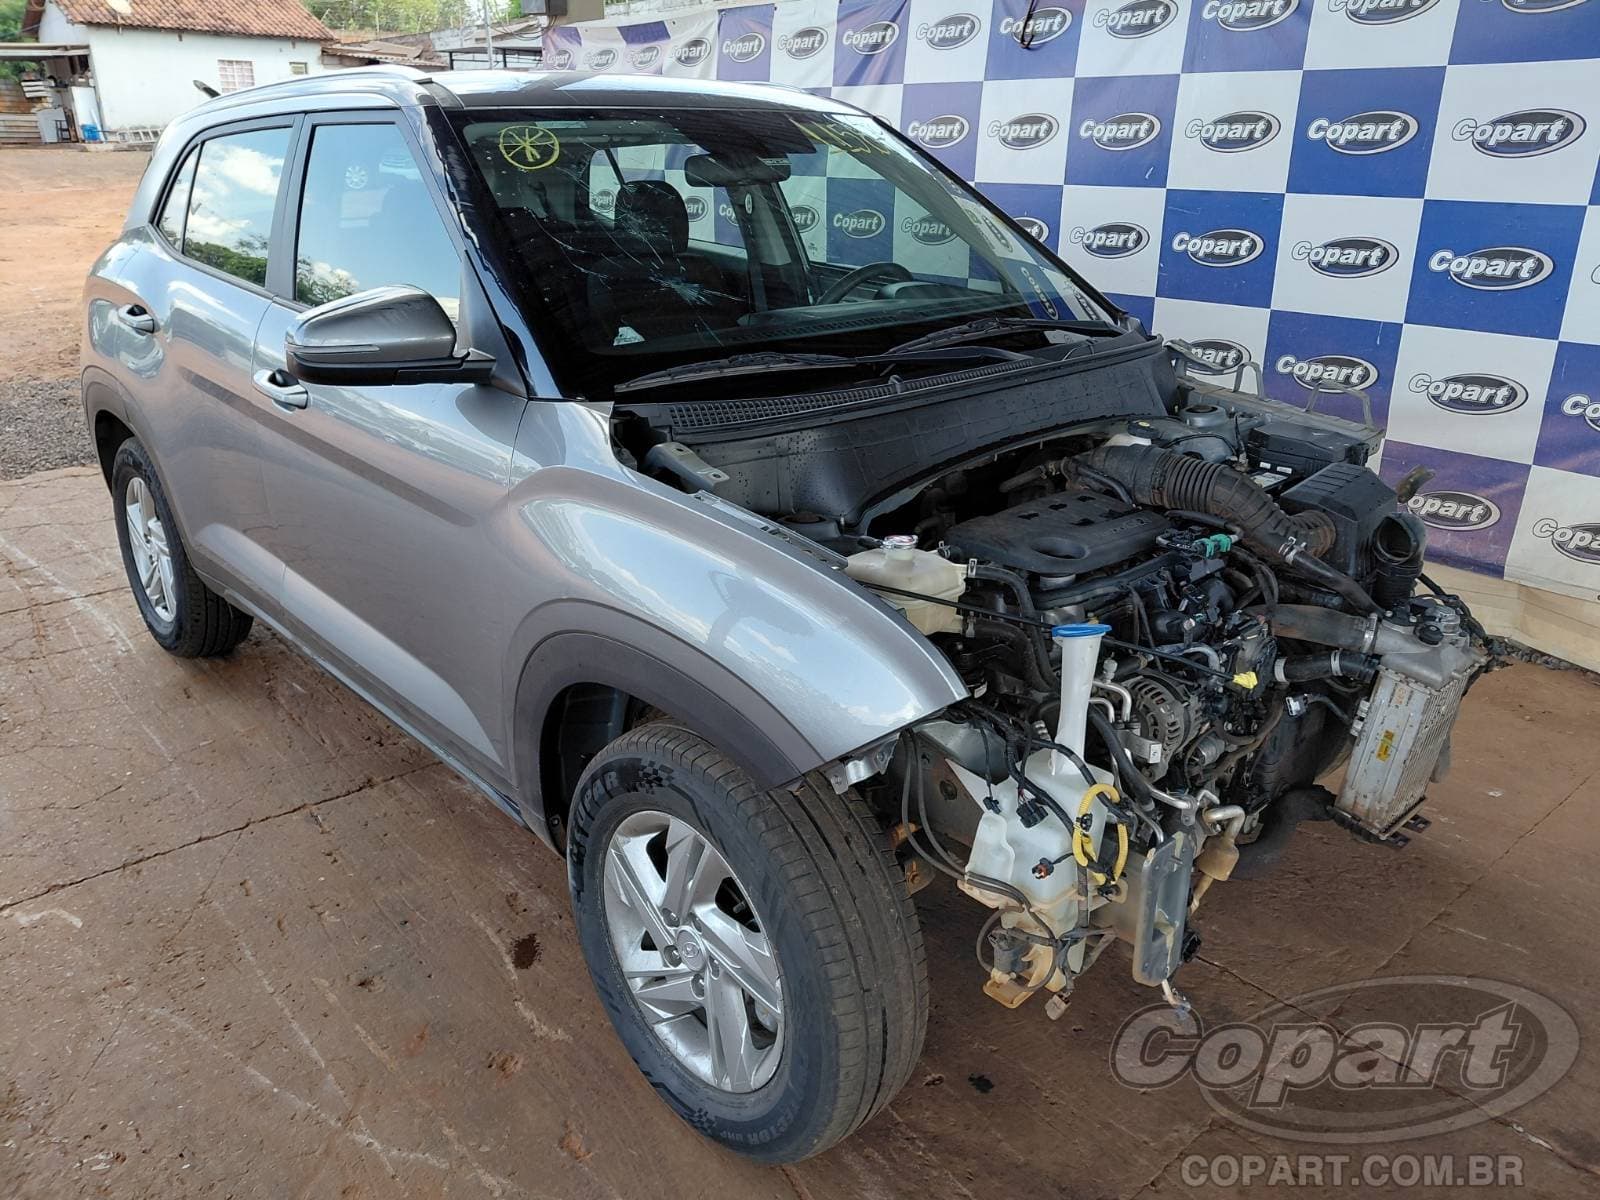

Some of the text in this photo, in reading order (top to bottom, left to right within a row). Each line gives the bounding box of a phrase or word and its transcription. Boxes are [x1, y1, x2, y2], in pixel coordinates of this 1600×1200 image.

[1094, 1, 1167, 31] Copart
[1201, 0, 1284, 22] Copart
[778, 33, 822, 50] Copart
[842, 25, 895, 47] Copart
[916, 19, 973, 46] Copart
[722, 39, 760, 56] Copart
[907, 119, 962, 145] Copart
[987, 119, 1052, 146] Copart
[1079, 118, 1153, 146] Copart
[1185, 117, 1269, 147] Copart
[1307, 116, 1407, 146] Copart
[1452, 115, 1567, 147] Copart
[833, 213, 878, 231] Copart
[1069, 228, 1143, 255] Copart
[1172, 231, 1253, 259] Copart
[1291, 240, 1386, 270] Copart
[1429, 249, 1539, 279] Copart
[1275, 354, 1367, 385] Copart
[1408, 373, 1514, 405] Copart
[1408, 494, 1485, 522] opart
